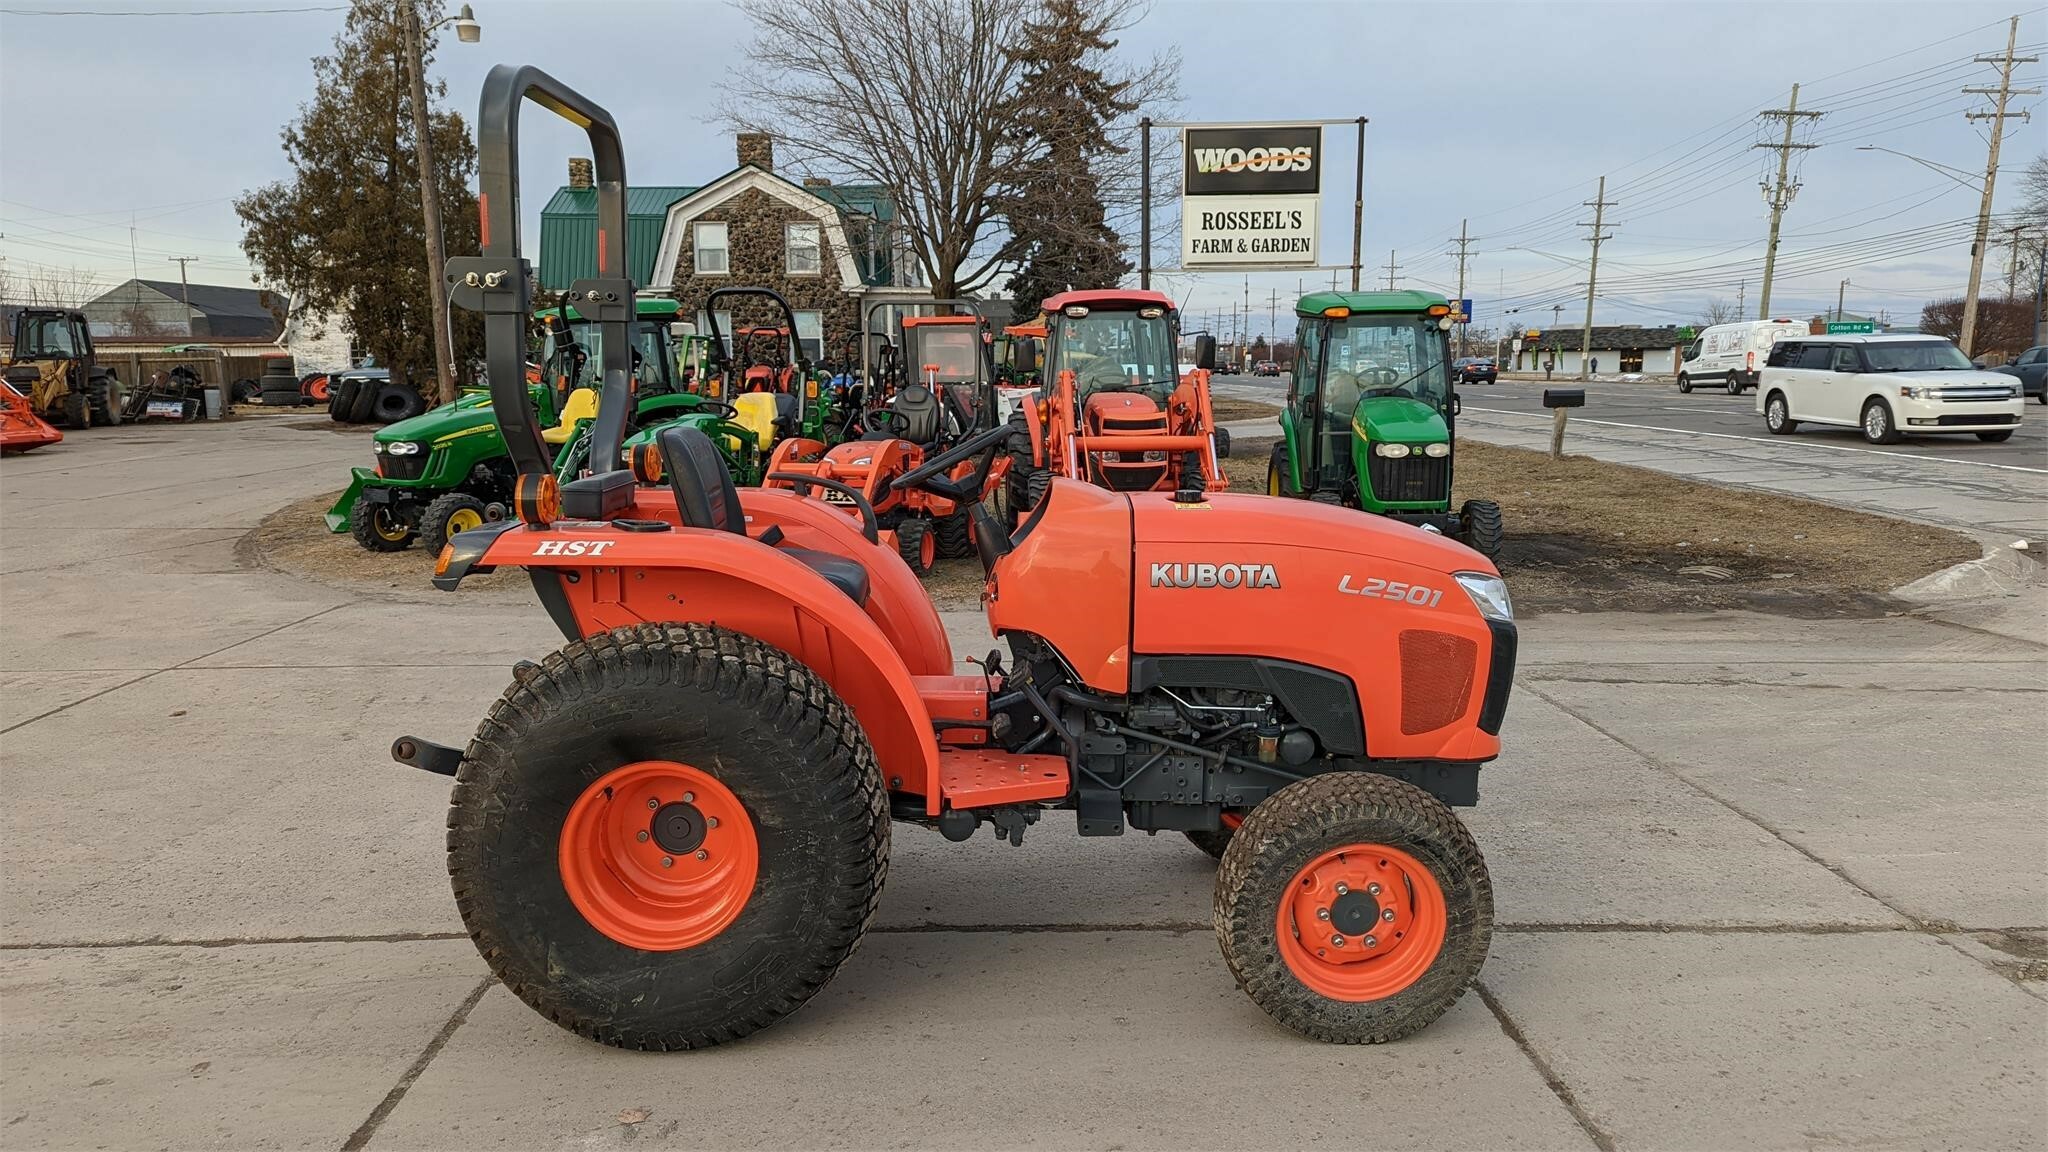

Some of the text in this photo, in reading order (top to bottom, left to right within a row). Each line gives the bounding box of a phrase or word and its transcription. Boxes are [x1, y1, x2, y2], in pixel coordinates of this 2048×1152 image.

[1193, 146, 1312, 173] WOODS
[1201, 210, 1302, 231] ROSSEEL'S
[1191, 237, 1311, 254] FARM & GARDEN
[532, 540, 615, 556] HST
[1150, 563, 1281, 589] KUBOTA
[1337, 574, 1444, 608] L2501
